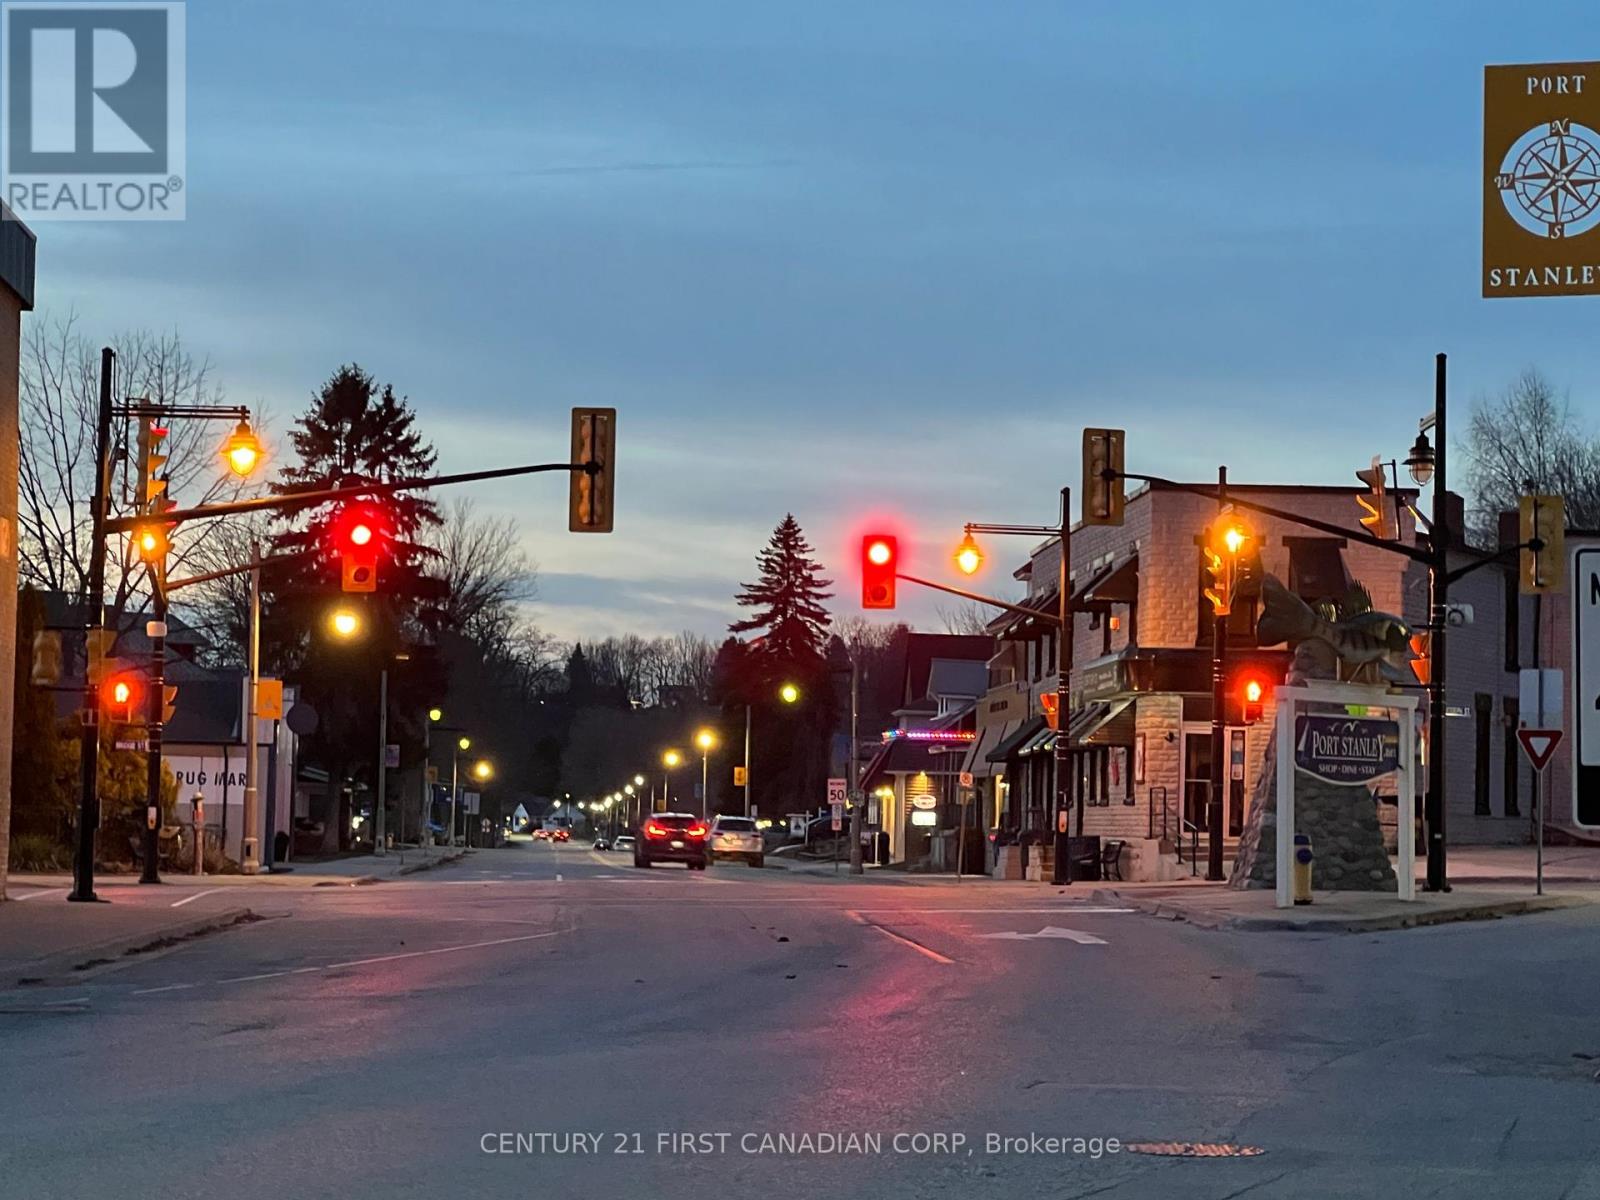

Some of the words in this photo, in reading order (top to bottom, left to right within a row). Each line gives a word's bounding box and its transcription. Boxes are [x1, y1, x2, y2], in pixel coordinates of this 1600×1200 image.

[1526, 75, 1586, 95] PORT
[1551, 118, 1569, 135] N
[1550, 225, 1562, 239] S
[1489, 265, 1600, 287] STANLE
[1312, 730, 1340, 758] PORT
[1341, 734, 1386, 762] STANLEY
[176, 771, 207, 786] RUG
[214, 772, 247, 786] MAR
[830, 789, 845, 801] 50
